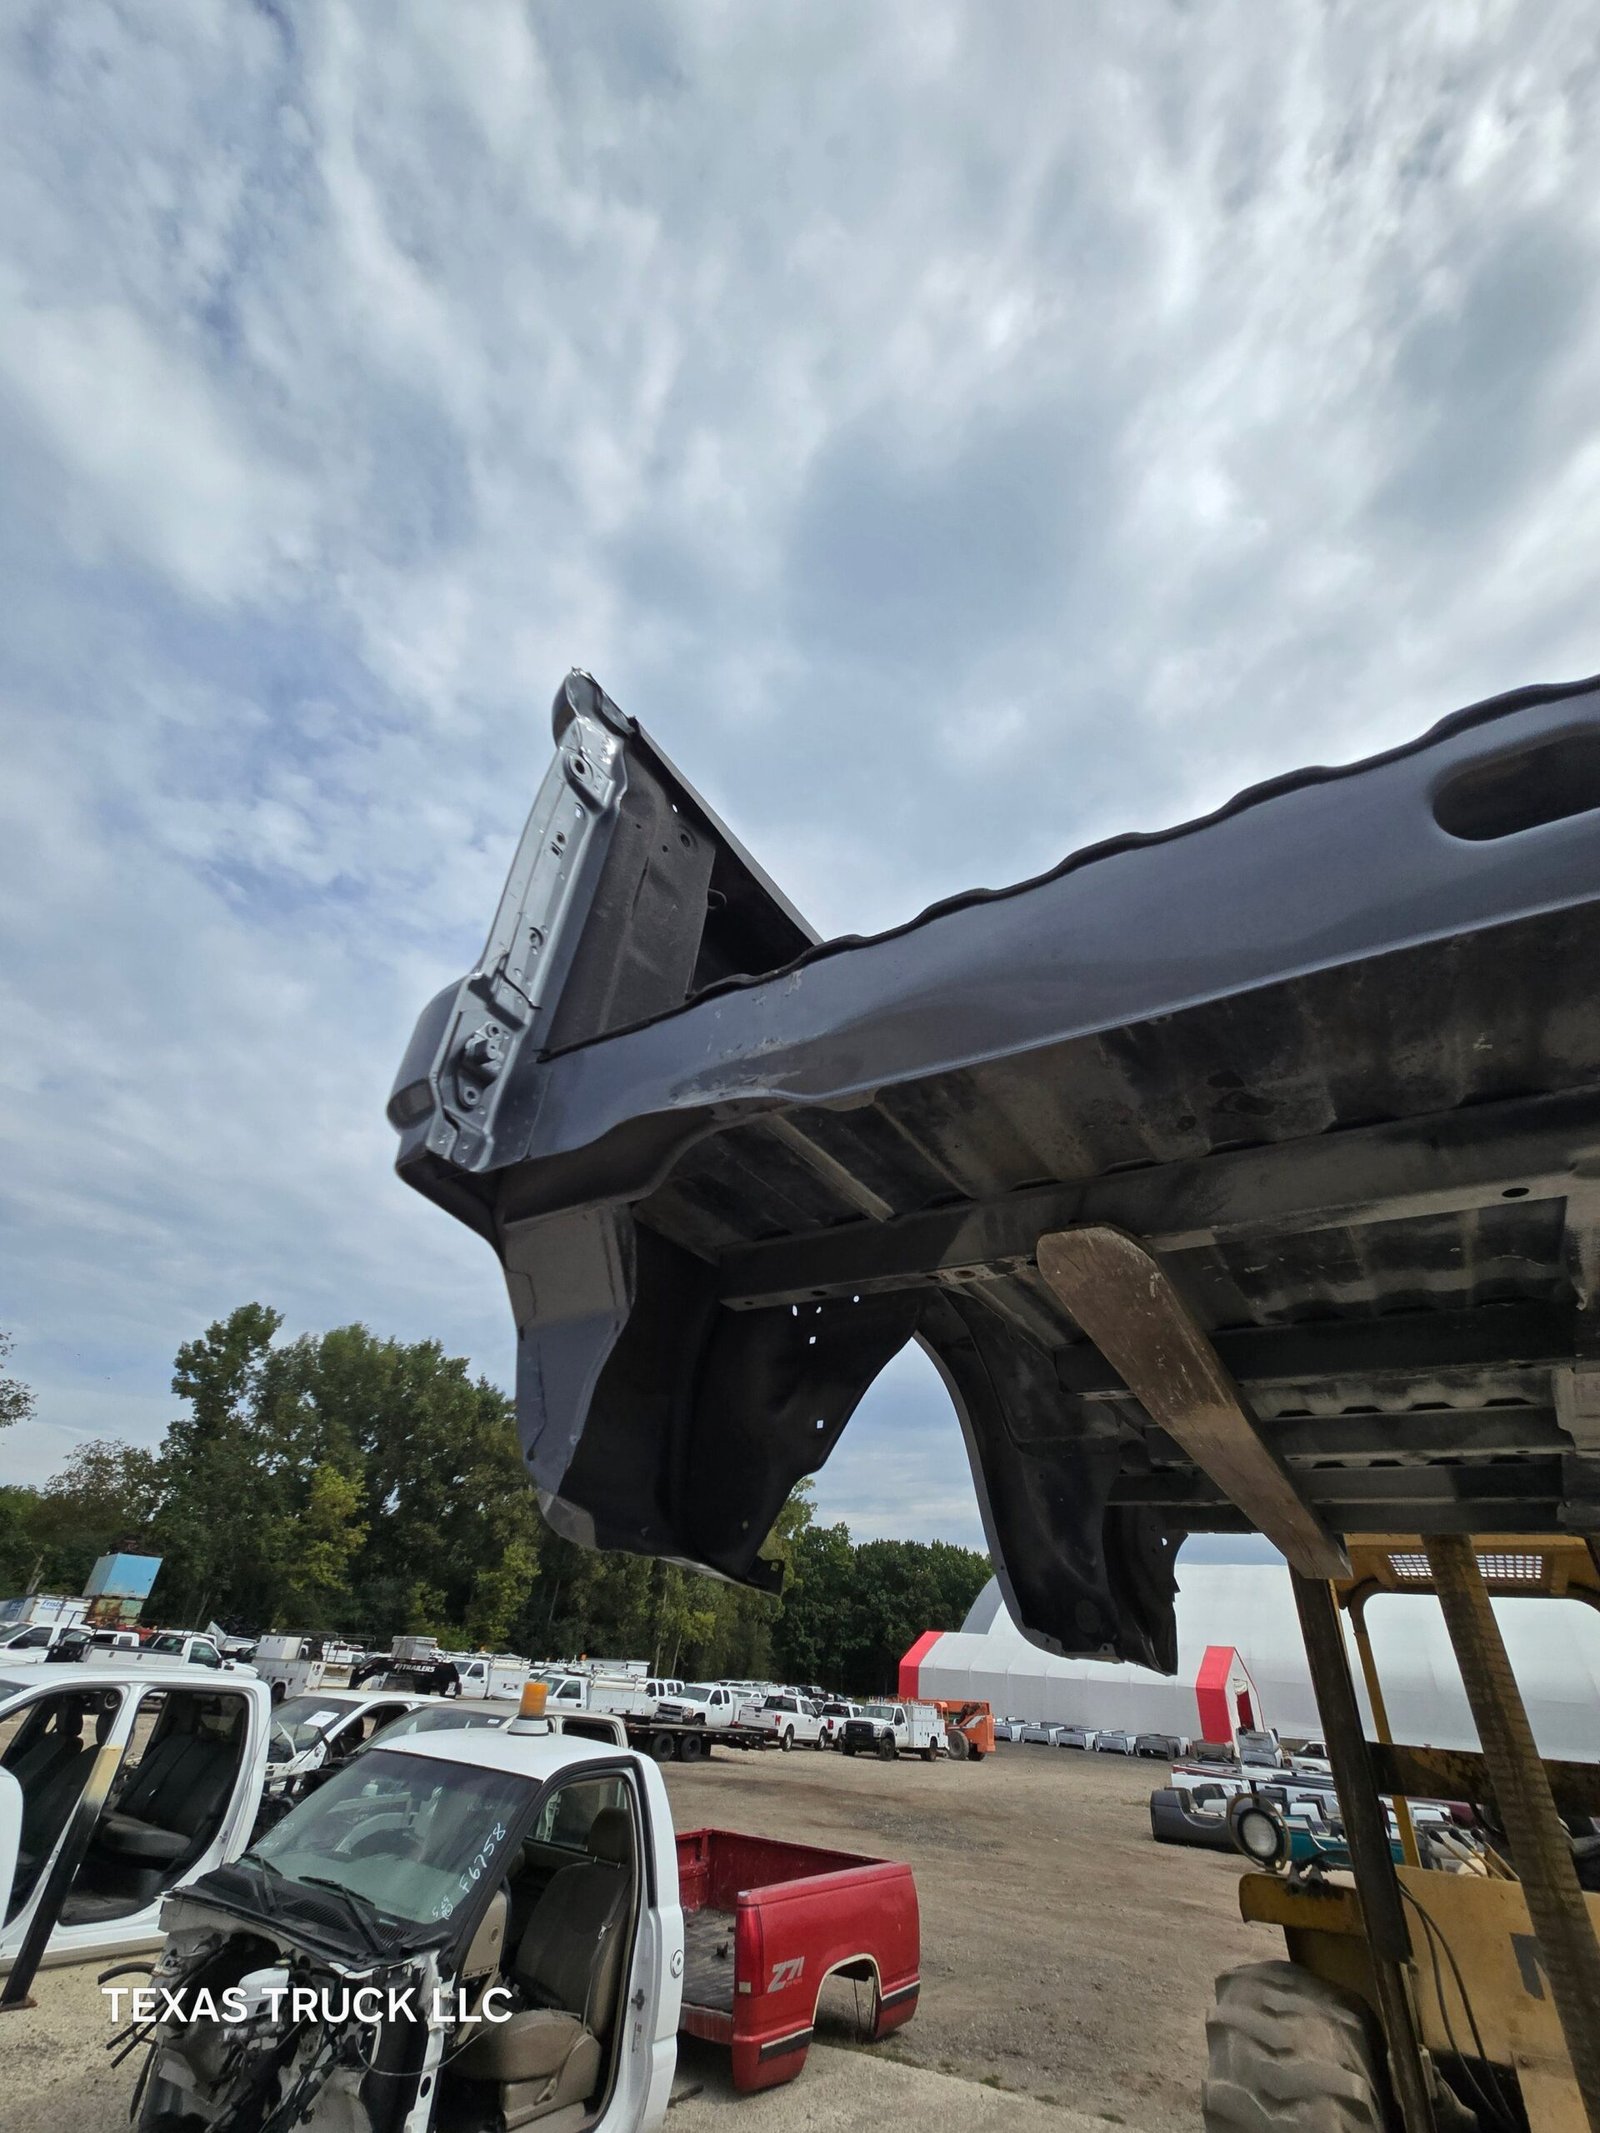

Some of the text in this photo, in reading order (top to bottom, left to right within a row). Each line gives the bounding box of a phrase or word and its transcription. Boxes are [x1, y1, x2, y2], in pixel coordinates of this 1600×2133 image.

[402, 1664, 436, 1673] TRAILERS
[458, 1822, 506, 1893] F6758
[767, 1956, 805, 1993] Z71
